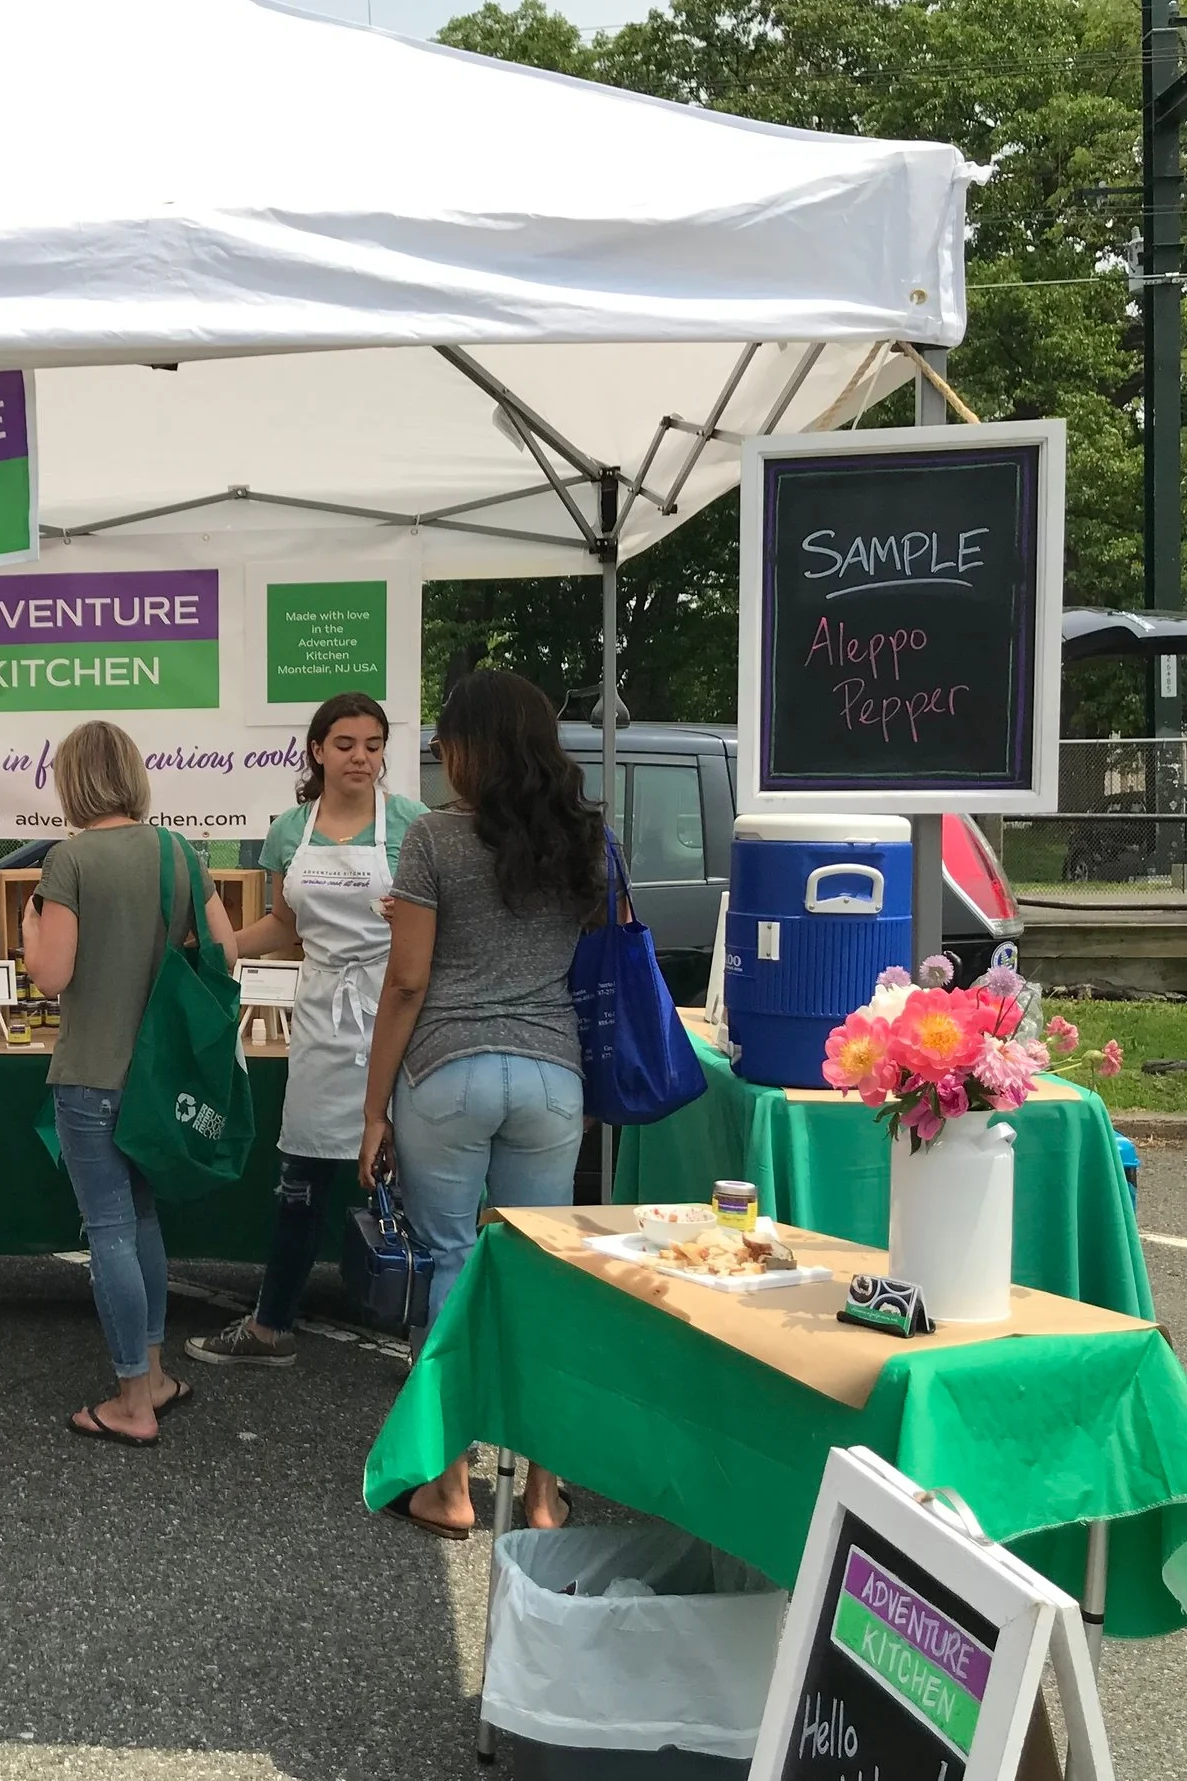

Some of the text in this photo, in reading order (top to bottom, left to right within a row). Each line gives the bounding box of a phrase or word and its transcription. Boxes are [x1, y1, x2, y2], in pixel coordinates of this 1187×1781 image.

[801, 527, 990, 579] SAMPLE
[285, 610, 370, 621] Made with love
[312, 624, 344, 634] in the
[298, 637, 358, 647] Adventure
[306, 650, 350, 660] Kitchen
[804, 616, 928, 680] Aleppo
[277, 663, 378, 674] Montclair, NJ USA
[832, 677, 970, 742] Pepper
[2, 747, 32, 772] in
[145, 736, 307, 775] curious cooks
[861, 1571, 974, 1679] ADVENTURE
[861, 1621, 956, 1723] KITCHEN
[798, 1691, 859, 1759] Hello
